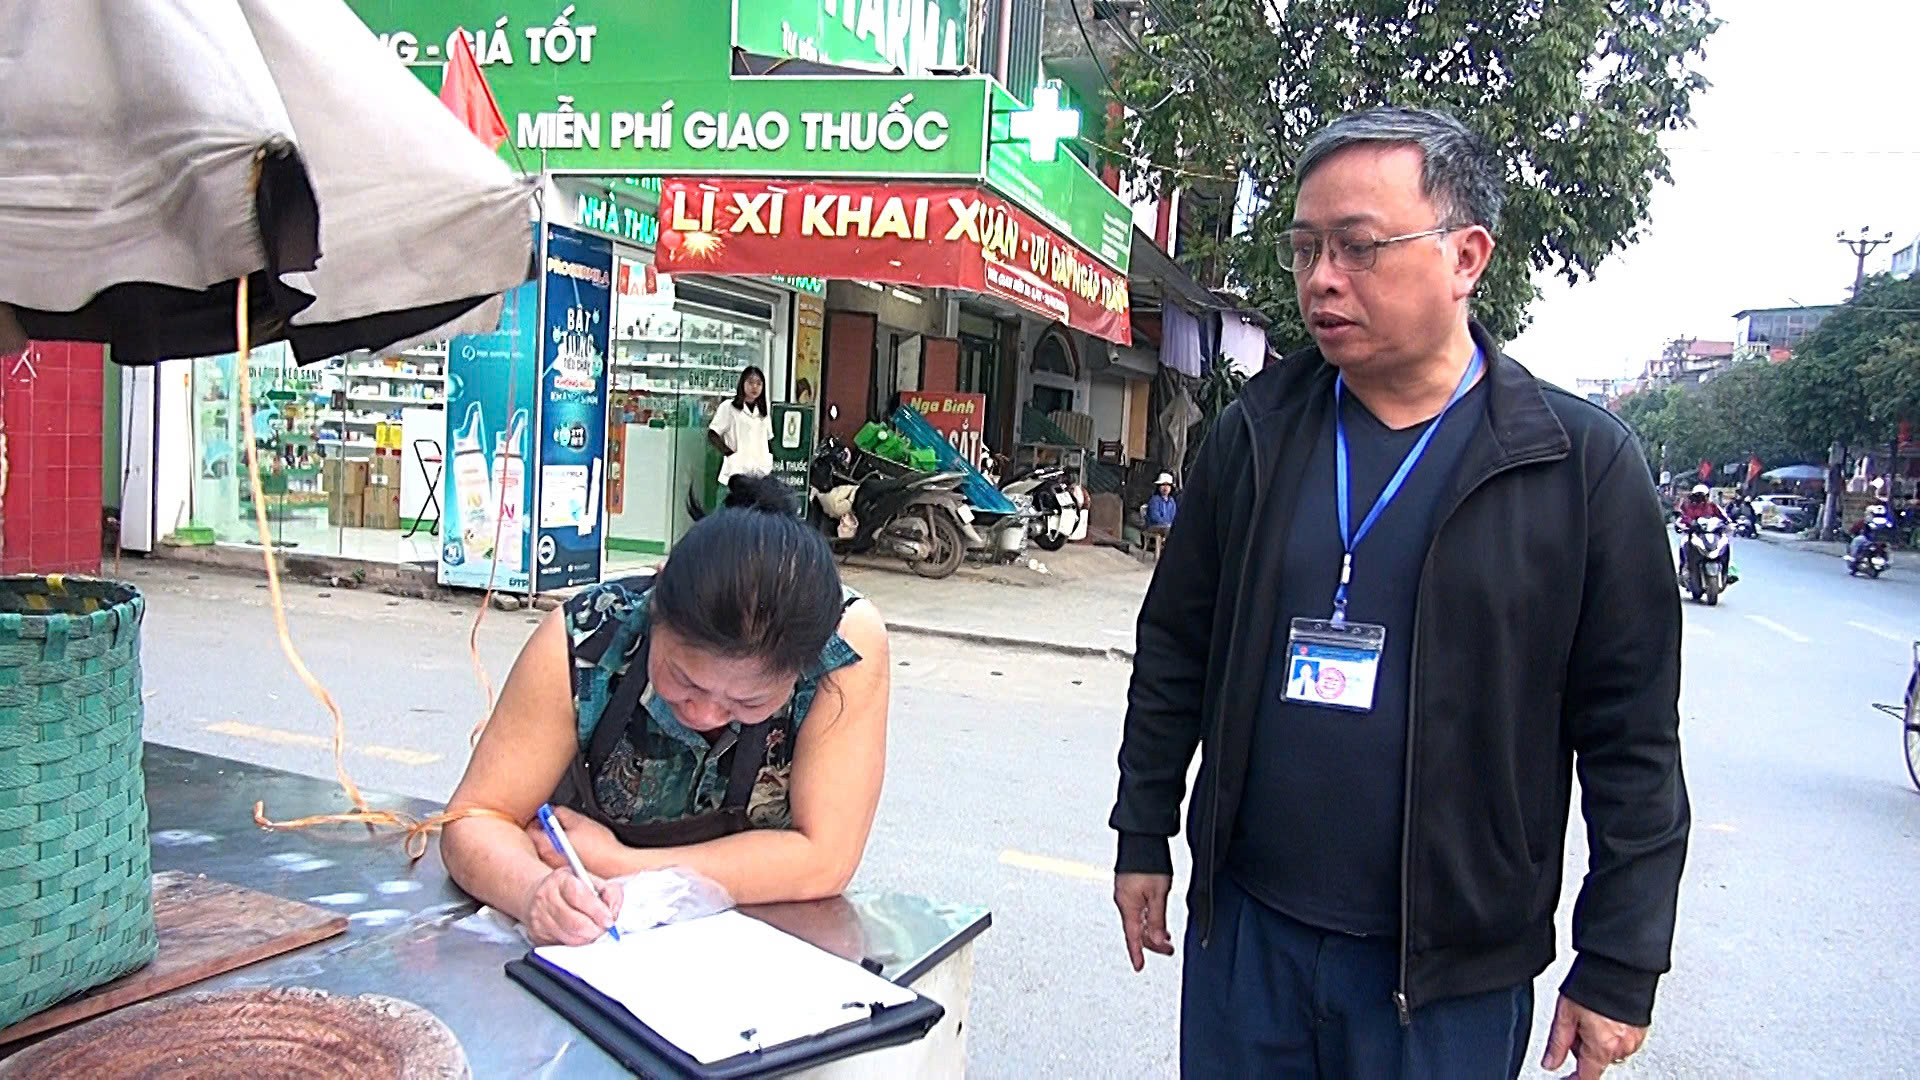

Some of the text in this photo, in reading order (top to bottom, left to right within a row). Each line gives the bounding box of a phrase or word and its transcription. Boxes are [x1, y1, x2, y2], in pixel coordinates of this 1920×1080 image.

[446, 16, 513, 66] GIÁ
[525, 4, 597, 64] TỐT
[517, 92, 949, 151] MIỄN PHÍ GIAO THUỐC
[577, 191, 660, 245] NHÀ THU
[672, 184, 721, 231] LÌ
[727, 186, 788, 235] XÌ
[801, 194, 928, 240] KHAI
[945, 198, 1019, 260] XUÂN
